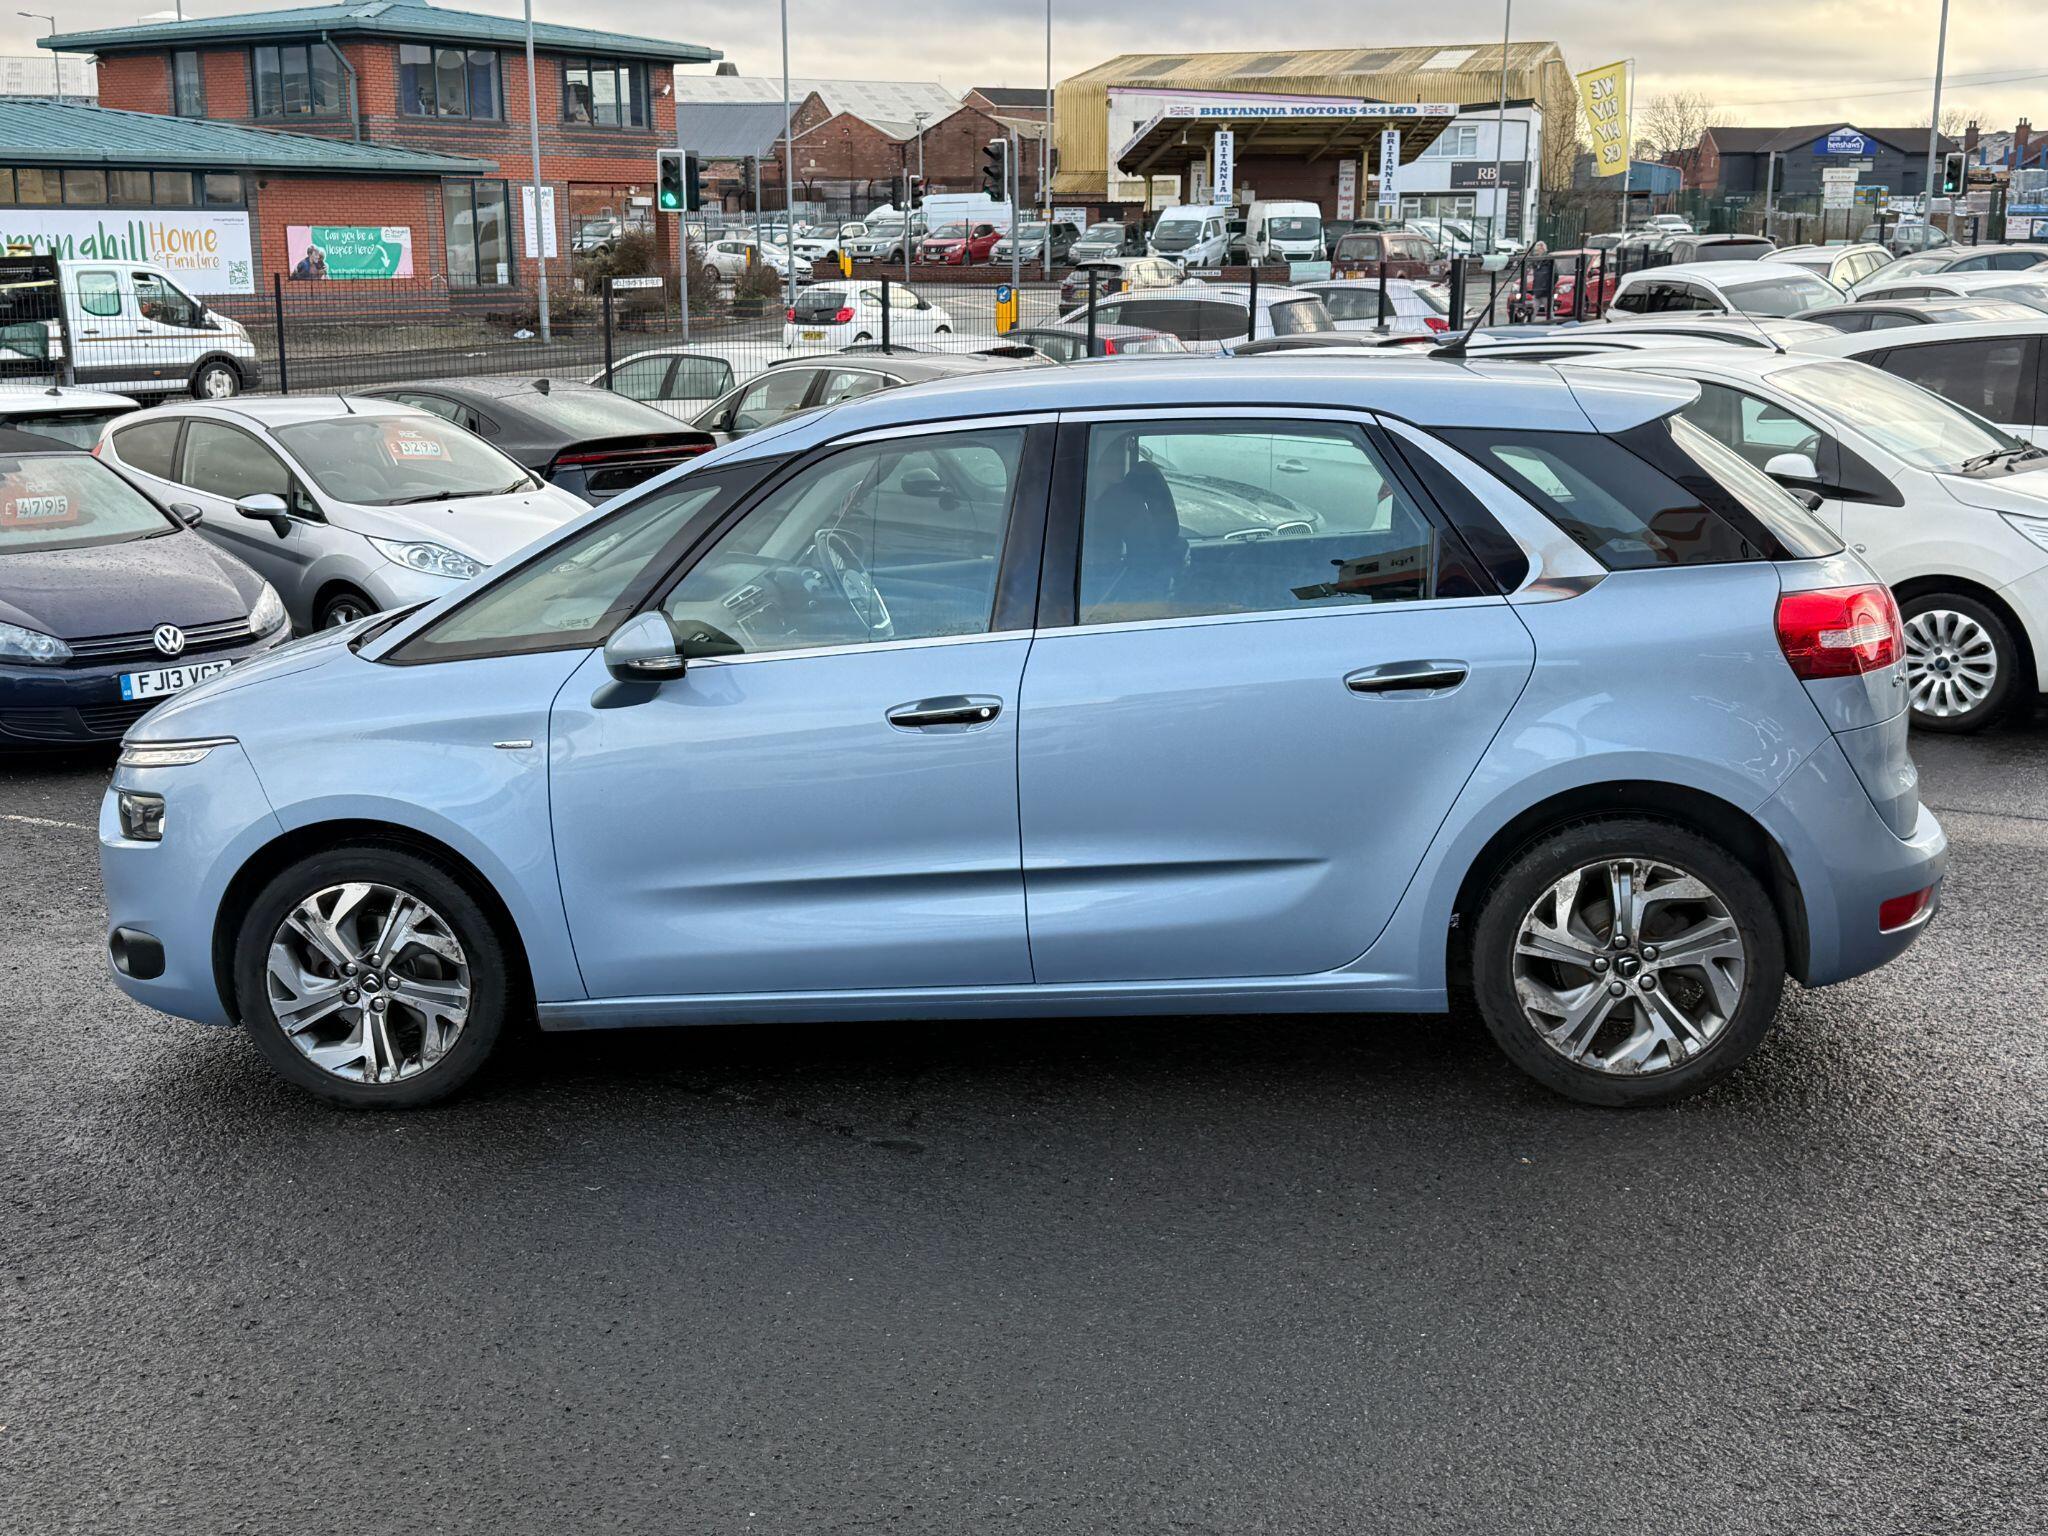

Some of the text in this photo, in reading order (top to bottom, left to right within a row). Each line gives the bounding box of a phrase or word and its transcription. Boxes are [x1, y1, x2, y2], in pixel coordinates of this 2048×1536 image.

[1200, 106, 1417, 116] BRITANNIA MOTORS 4x4 LTD
[1220, 133, 1228, 193] BRITANNIA
[1384, 132, 1395, 191] BRITANNIA
[1477, 167, 1497, 180] RB
[149, 221, 218, 252] Home
[325, 230, 339, 240] Can
[341, 231, 356, 244] you
[357, 230, 366, 240] be
[154, 251, 220, 269] & Furniture
[326, 244, 375, 258] Hospice Hero?
[138, 669, 184, 693] FJ13
